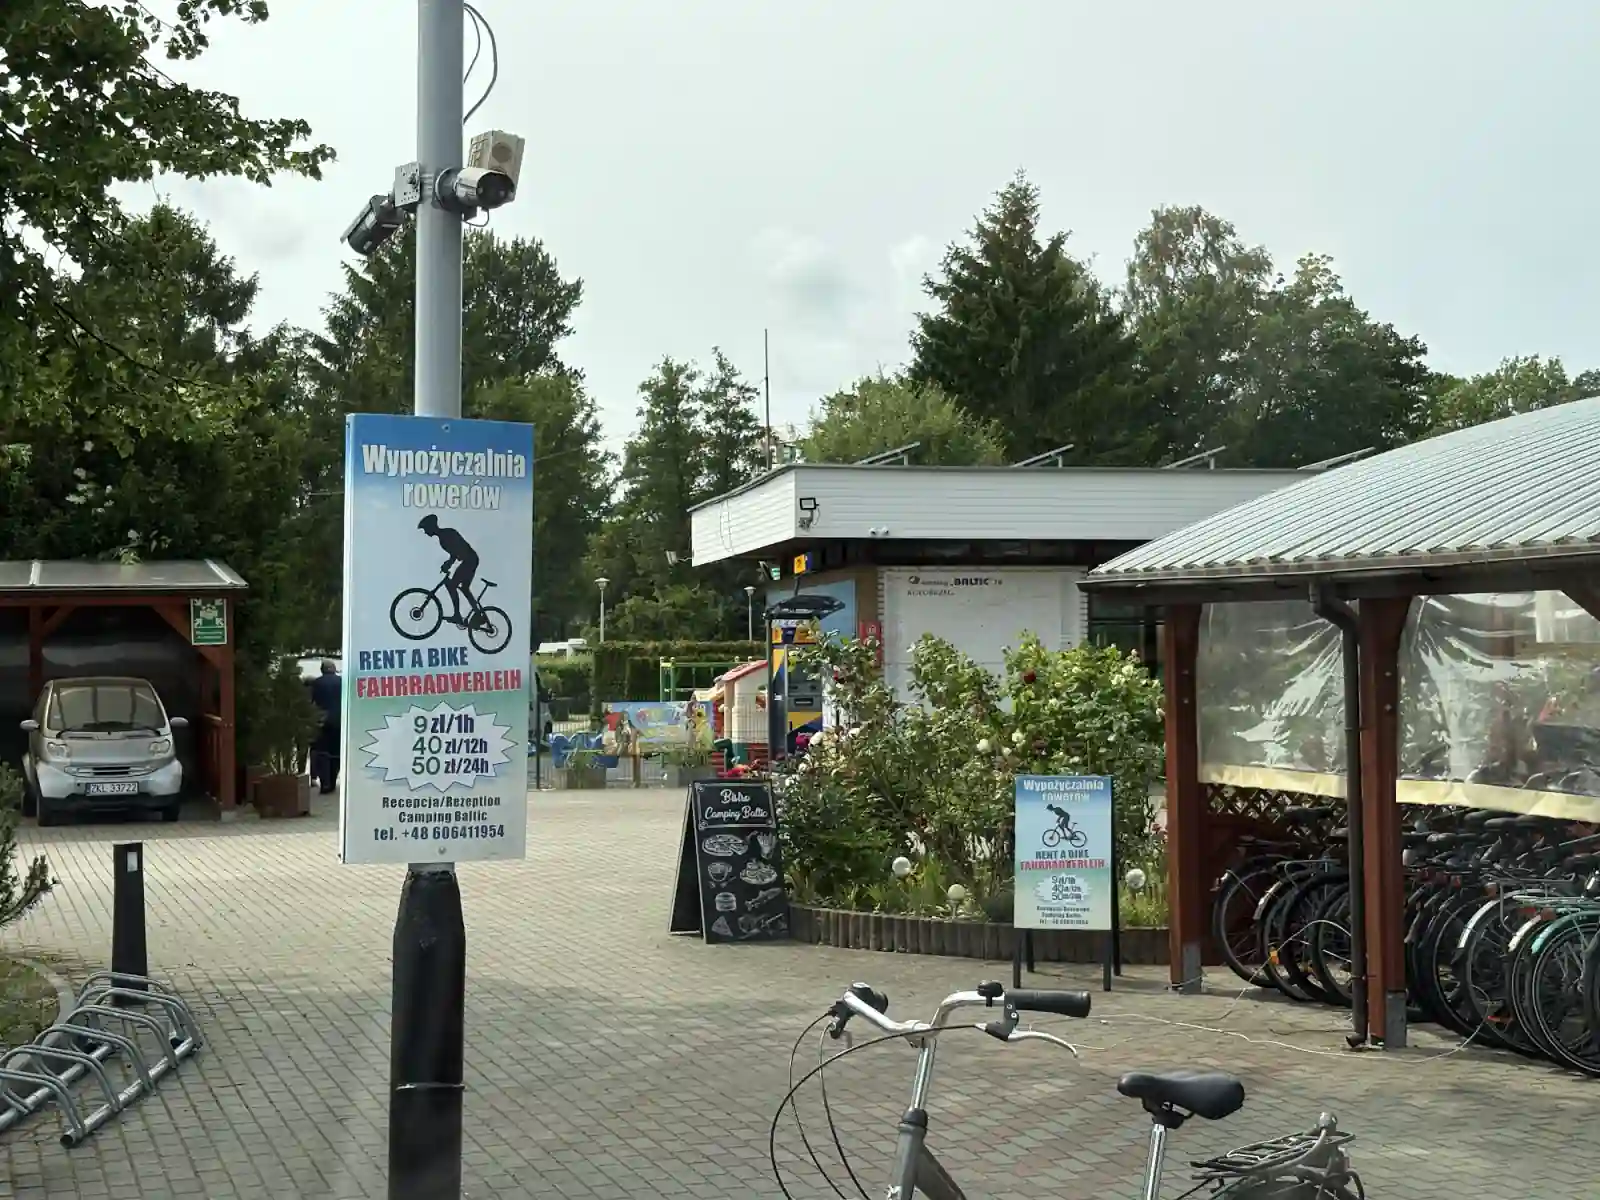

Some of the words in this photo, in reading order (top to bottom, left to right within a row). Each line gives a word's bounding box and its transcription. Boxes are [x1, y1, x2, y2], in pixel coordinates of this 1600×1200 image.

[362, 444, 526, 478] Wypożyczalnia
[402, 479, 501, 510] rowerów
[359, 649, 406, 671] RENT
[411, 649, 423, 668] A
[428, 646, 469, 668] BIKE
[356, 669, 522, 698] FAHRRADVERLEIH
[413, 715, 428, 734] 9
[412, 735, 442, 755] 40
[411, 756, 441, 775] 50
[382, 796, 501, 809] Recepcja/Rezeption
[398, 811, 452, 824] Camping
[454, 810, 488, 822] Baltic
[704, 806, 741, 821] Camping
[741, 805, 768, 819] Baltic
[374, 827, 398, 841] tel.
[402, 826, 429, 840] +48
[432, 824, 505, 840] 606411954
